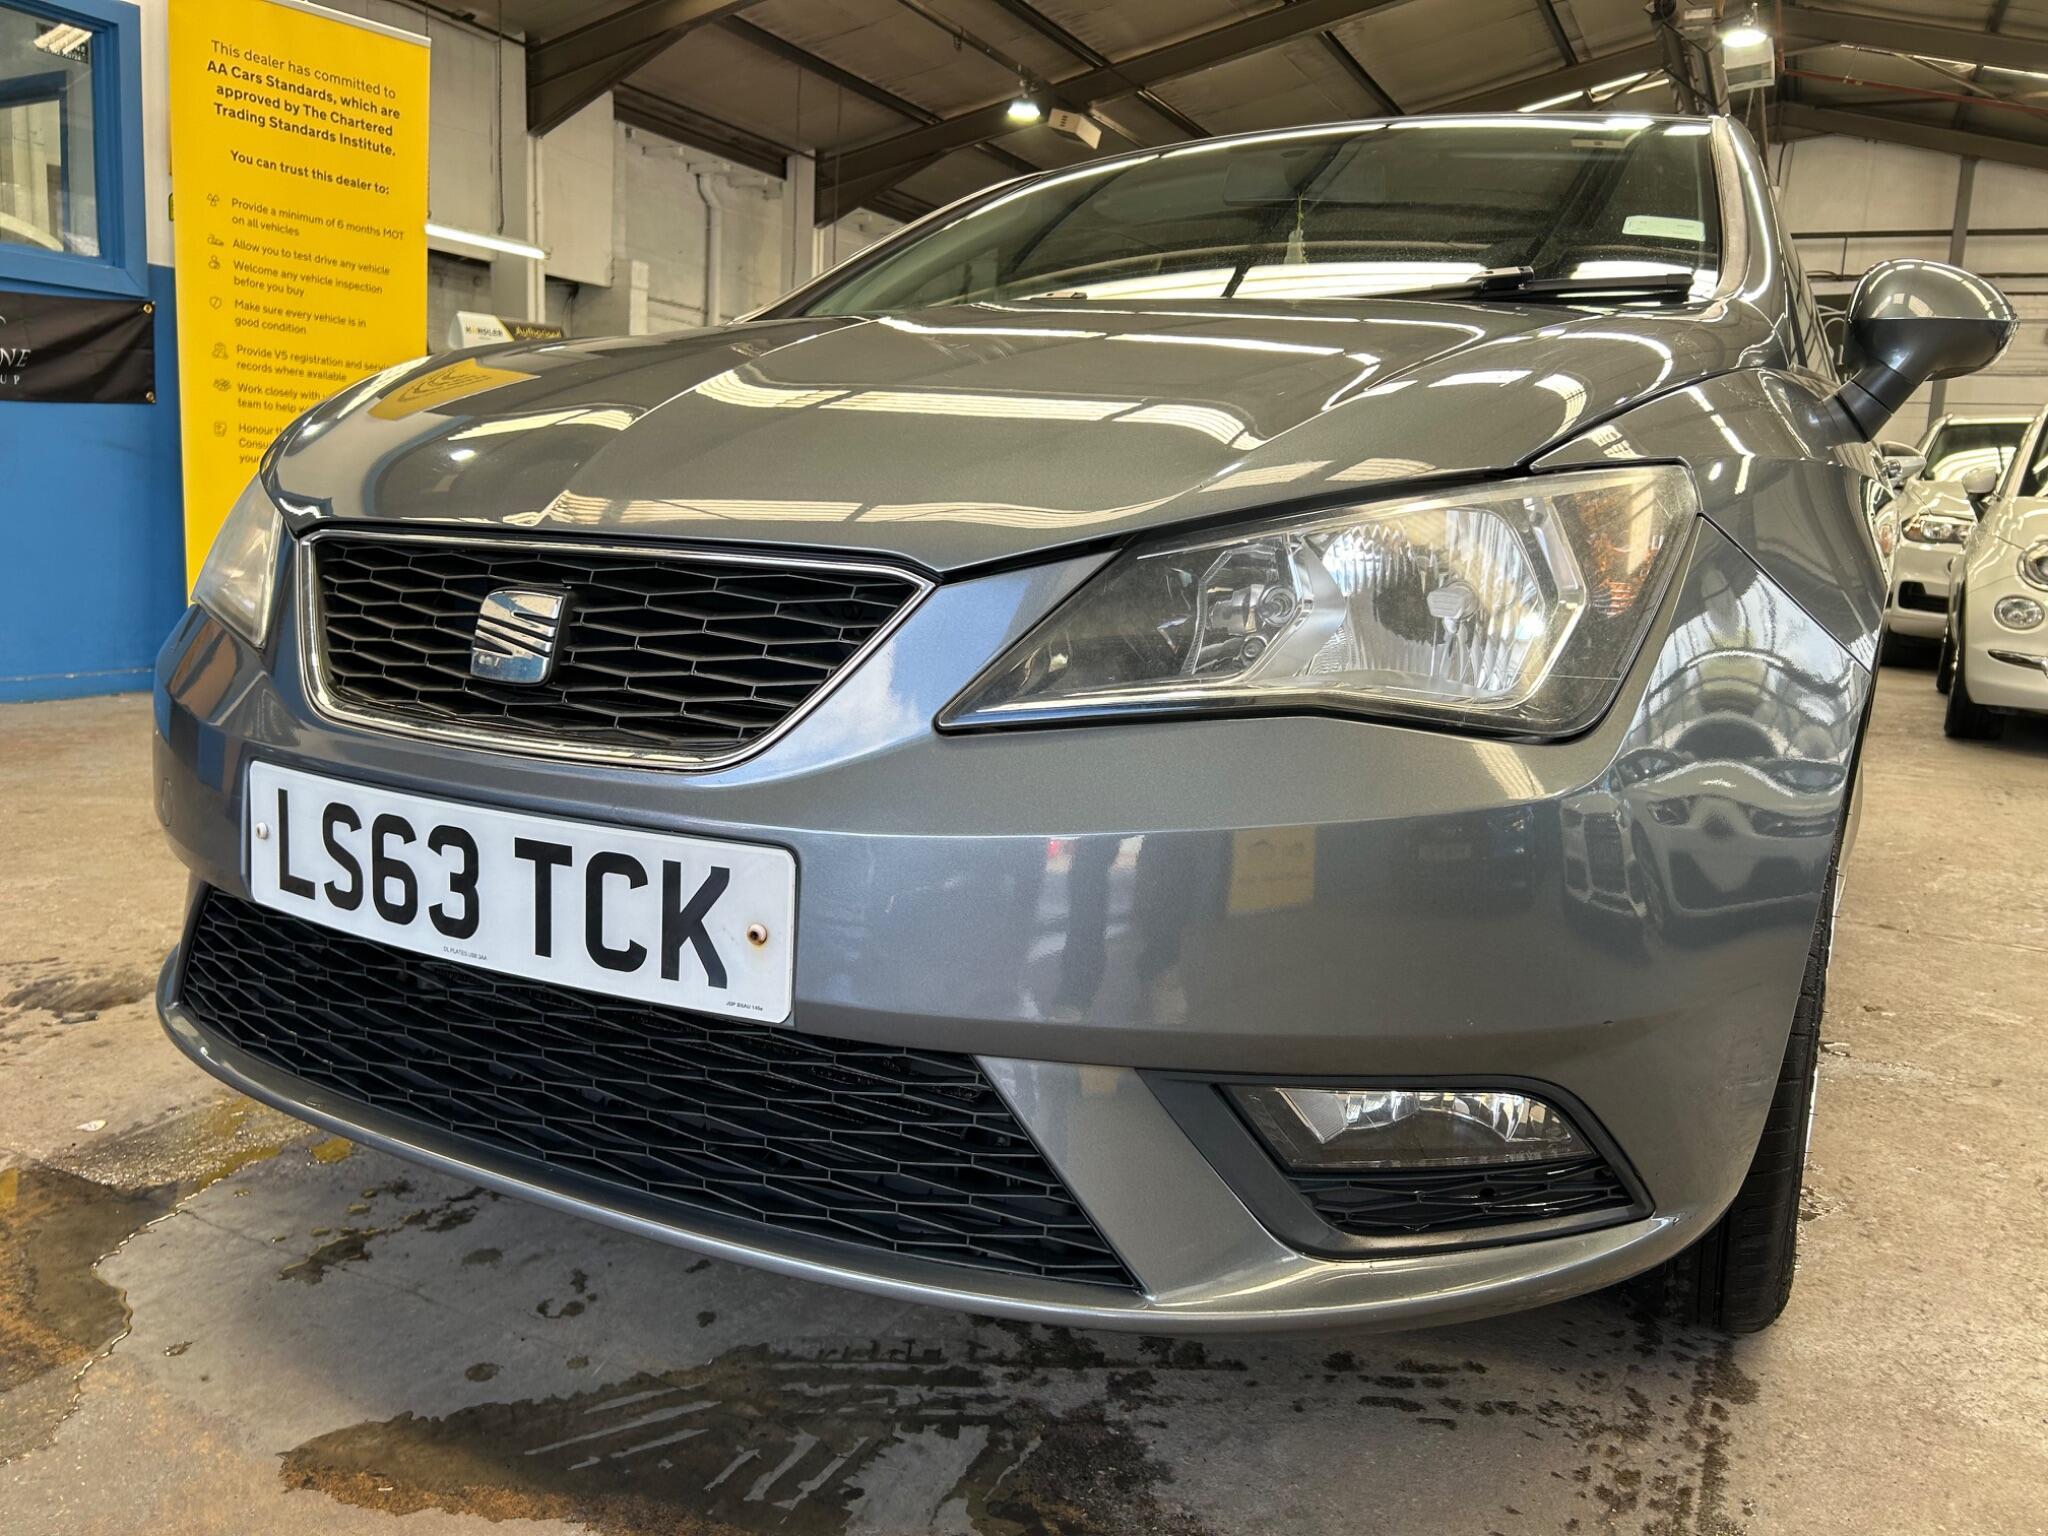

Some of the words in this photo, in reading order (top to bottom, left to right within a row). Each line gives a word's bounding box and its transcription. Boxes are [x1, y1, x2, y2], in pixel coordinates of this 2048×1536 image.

[211, 40, 240, 58] This
[244, 50, 284, 69] dealer
[289, 61, 310, 76] has
[315, 69, 380, 95] committed
[384, 86, 395, 99] to
[207, 61, 228, 76] AA
[231, 66, 262, 84] Cars
[266, 75, 337, 105] Standards,
[341, 96, 377, 113] which
[381, 107, 400, 119] are
[217, 85, 280, 109] approved
[285, 100, 299, 116] by
[303, 104, 326, 120] The
[331, 112, 392, 136] Chartered
[214, 102, 266, 127] Trading
[269, 116, 336, 142] Standards
[340, 133, 395, 156] Institute.
[230, 150, 252, 165] You
[257, 159, 276, 170] can
[280, 162, 308, 177] trust
[312, 169, 332, 183] this
[336, 175, 371, 191] dealer
[374, 182, 389, 195] to:
[232, 198, 268, 215] Provide
[271, 208, 276, 216] a
[279, 209, 323, 225] minimum
[326, 217, 335, 228] of
[337, 219, 343, 229] 6
[346, 222, 380, 237] months
[383, 229, 404, 240] MOT
[232, 216, 244, 226] on
[247, 218, 258, 229] all
[261, 221, 299, 236] vehicles
[233, 239, 259, 253] Allow
[262, 244, 278, 257] you
[281, 249, 291, 258] to
[294, 251, 312, 262] test
[315, 255, 337, 267] drive
[340, 261, 356, 271] any
[358, 262, 390, 276] vehicle
[233, 260, 278, 278] Welcome
[281, 270, 297, 282] any
[300, 272, 333, 287] vehicle
[335, 278, 382, 294] inspection
[234, 276, 264, 290] before
[267, 281, 284, 294] you
[286, 281, 304, 298] buy
[235, 300, 260, 312] Make
[263, 305, 283, 316] sure
[286, 309, 312, 321] every
[314, 311, 345, 325] vehicle
[349, 316, 356, 327] is
[358, 318, 366, 328] in
[235, 317, 259, 328] good
[262, 319, 306, 335] condition
[237, 344, 271, 359] Provide
[274, 349, 288, 360] V5
[291, 352, 343, 368] registration
[346, 358, 362, 369] and
[237, 363, 272, 373] records
[276, 365, 304, 376] where
[307, 368, 346, 382] available
[237, 383, 262, 394] Work
[265, 385, 298, 400] closely
[301, 389, 320, 400] with
[238, 399, 261, 408] team
[264, 400, 273, 409] to
[276, 402, 296, 413] help
[239, 424, 273, 435] Honour
[240, 455, 259, 464] your
[277, 788, 480, 940] LS63
[514, 837, 730, 989] TCK
